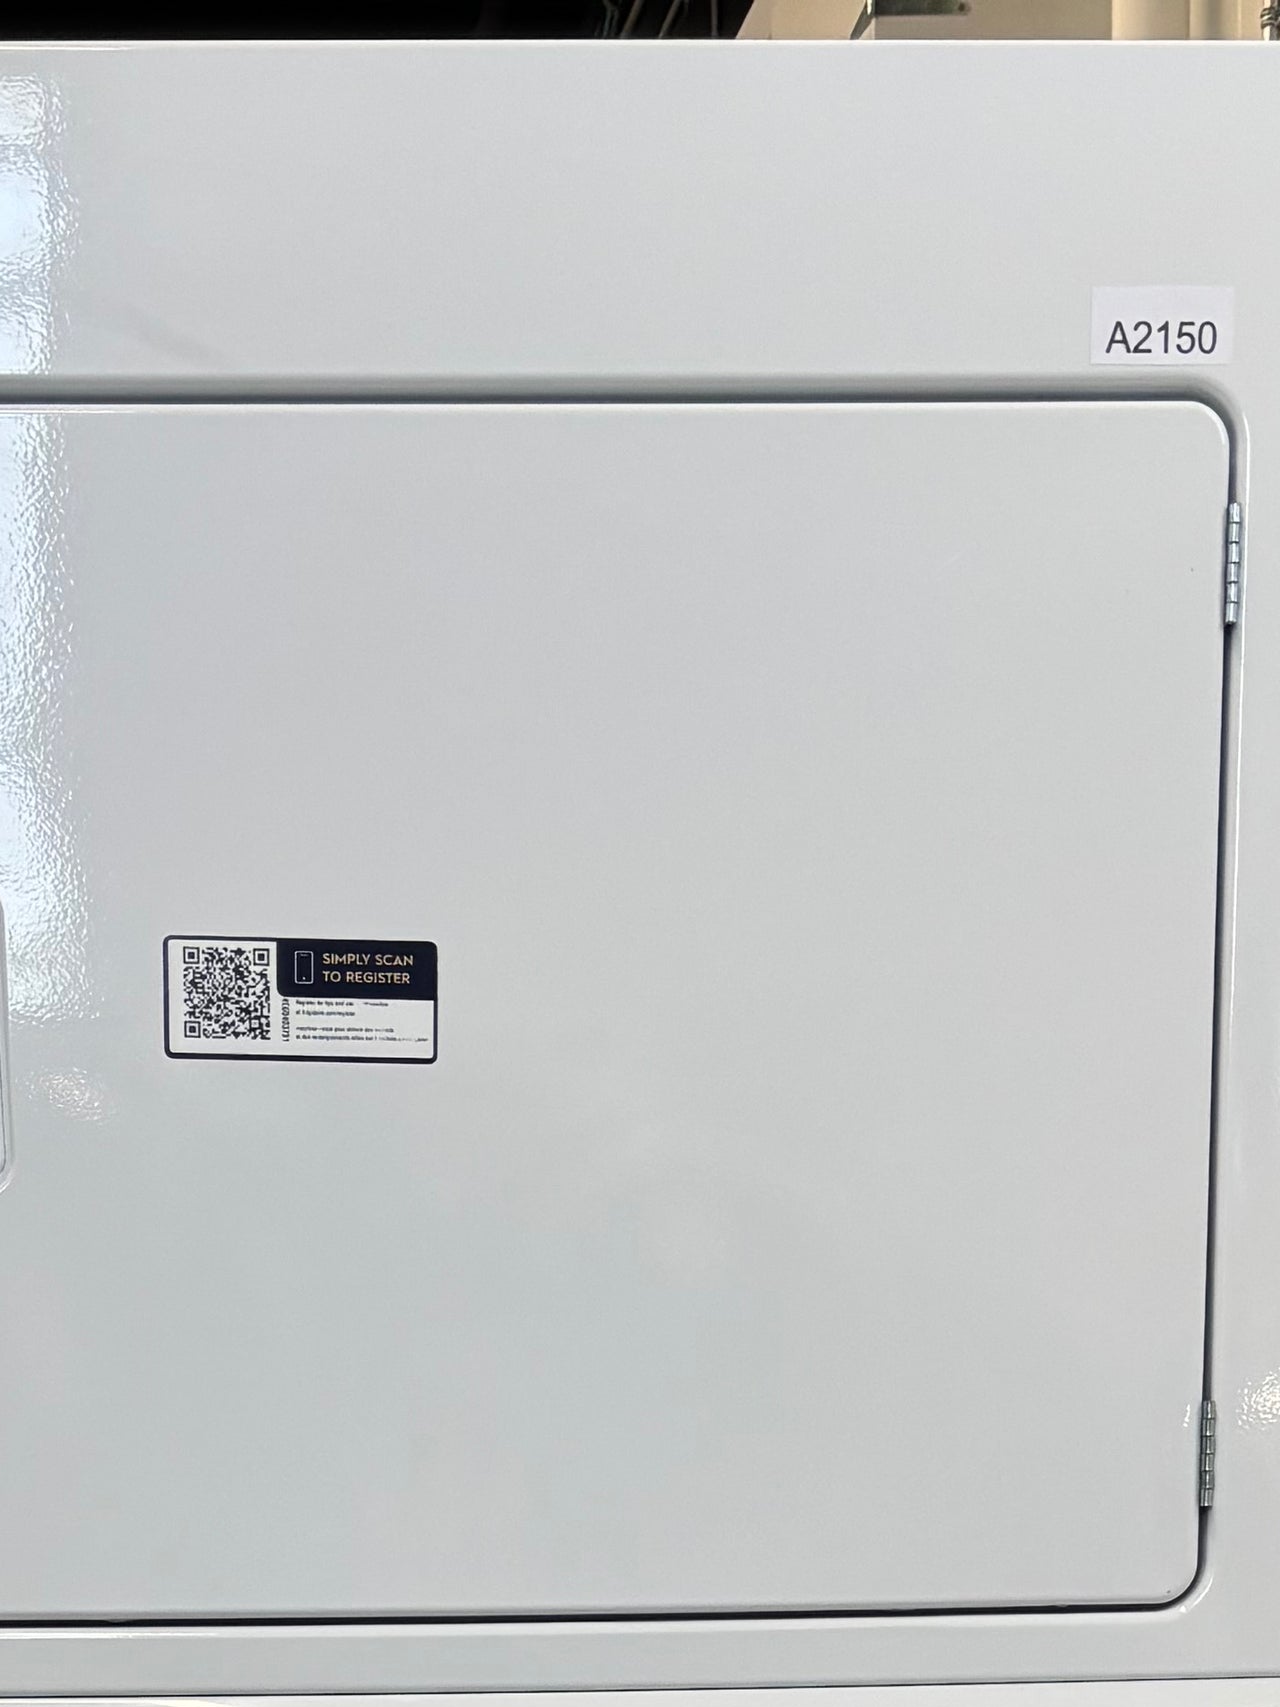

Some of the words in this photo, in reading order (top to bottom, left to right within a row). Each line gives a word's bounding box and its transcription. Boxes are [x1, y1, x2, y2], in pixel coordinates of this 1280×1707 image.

[1105, 320, 1218, 354] A2150
[322, 953, 371, 965] SIMPLY
[375, 954, 414, 966] SCAN
[322, 971, 341, 982] TO
[346, 971, 410, 984] REGISTER
